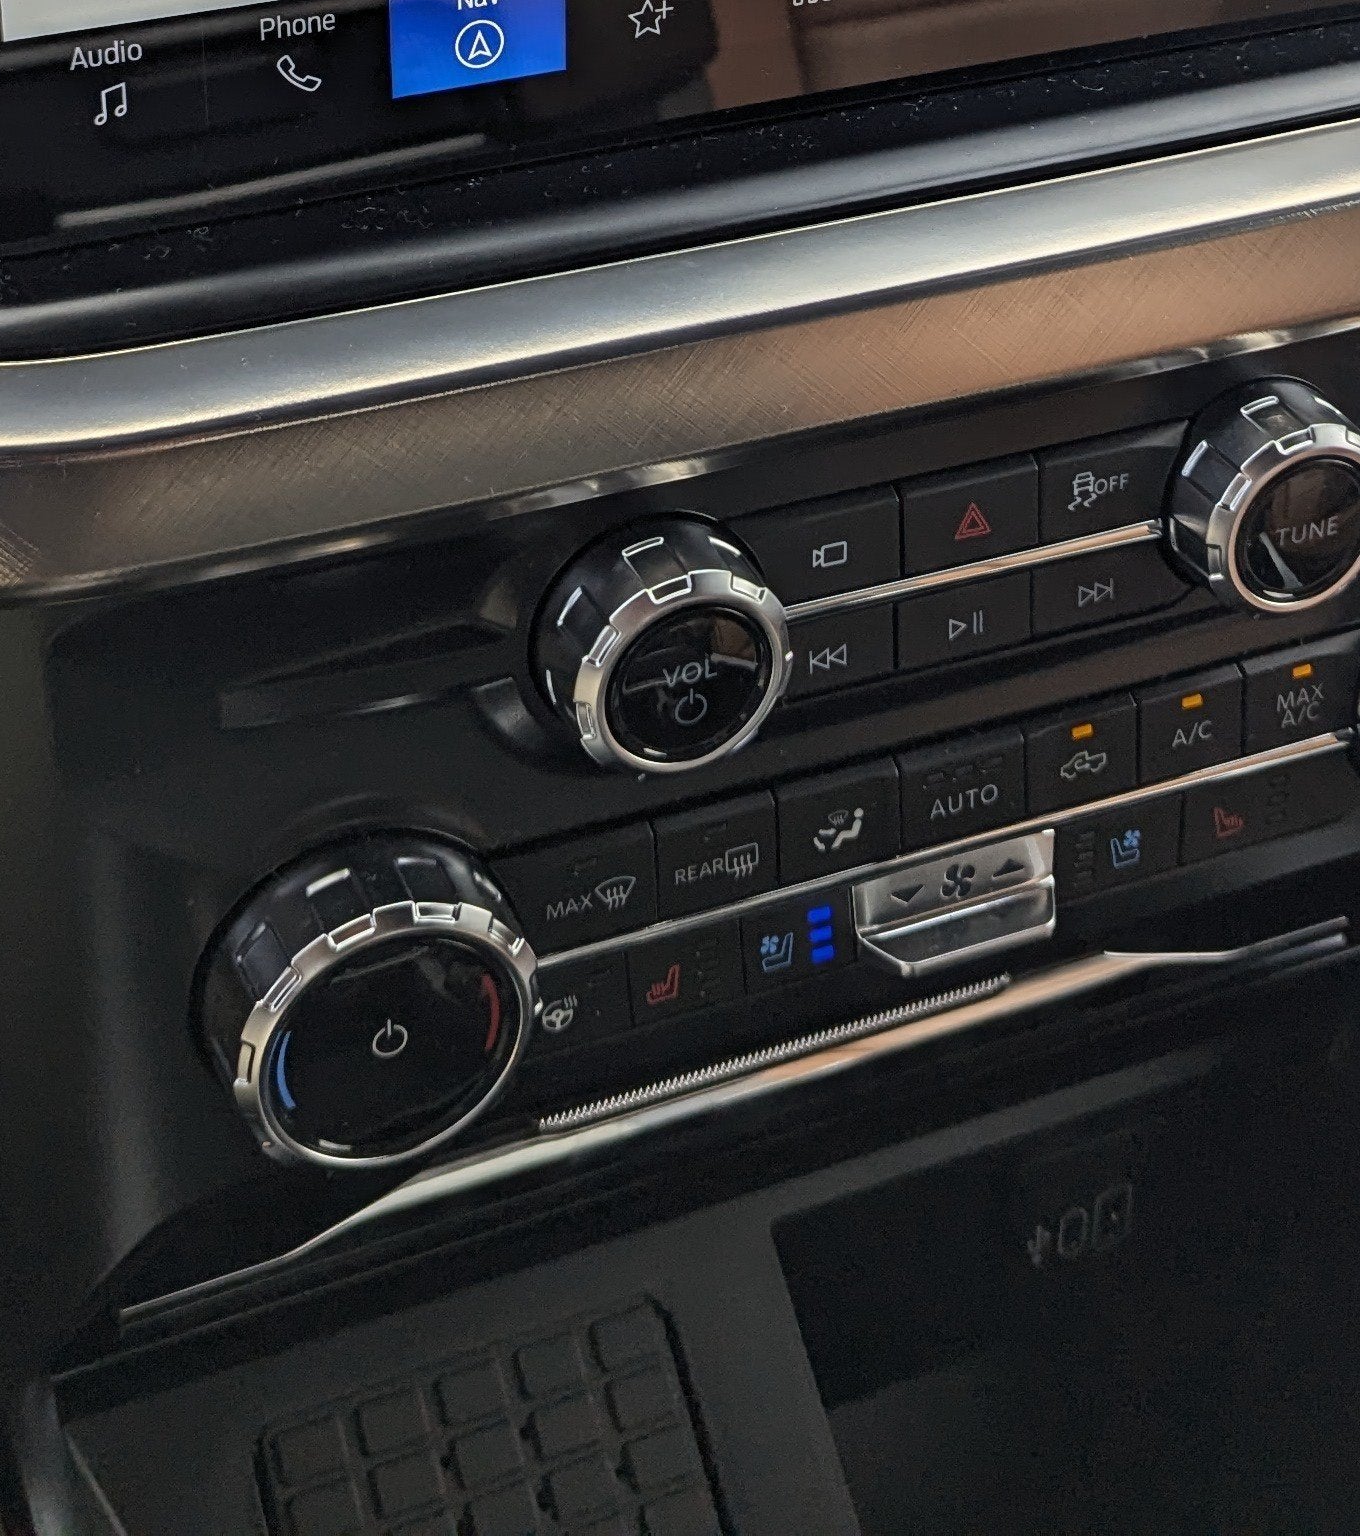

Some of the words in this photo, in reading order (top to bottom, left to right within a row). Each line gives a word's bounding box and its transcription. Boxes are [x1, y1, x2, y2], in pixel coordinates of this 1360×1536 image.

[260, 10, 335, 41] Phone
[70, 39, 142, 72] Audio
[1095, 471, 1130, 494] OFF
[1275, 516, 1339, 542] TUNE
[663, 658, 718, 687] VOL
[1277, 684, 1325, 709] MAX
[1280, 701, 1321, 726] A/C
[1172, 721, 1213, 746] A/C
[929, 783, 999, 820] AUTO
[674, 859, 726, 882] REAR
[546, 894, 593, 919] MAX
